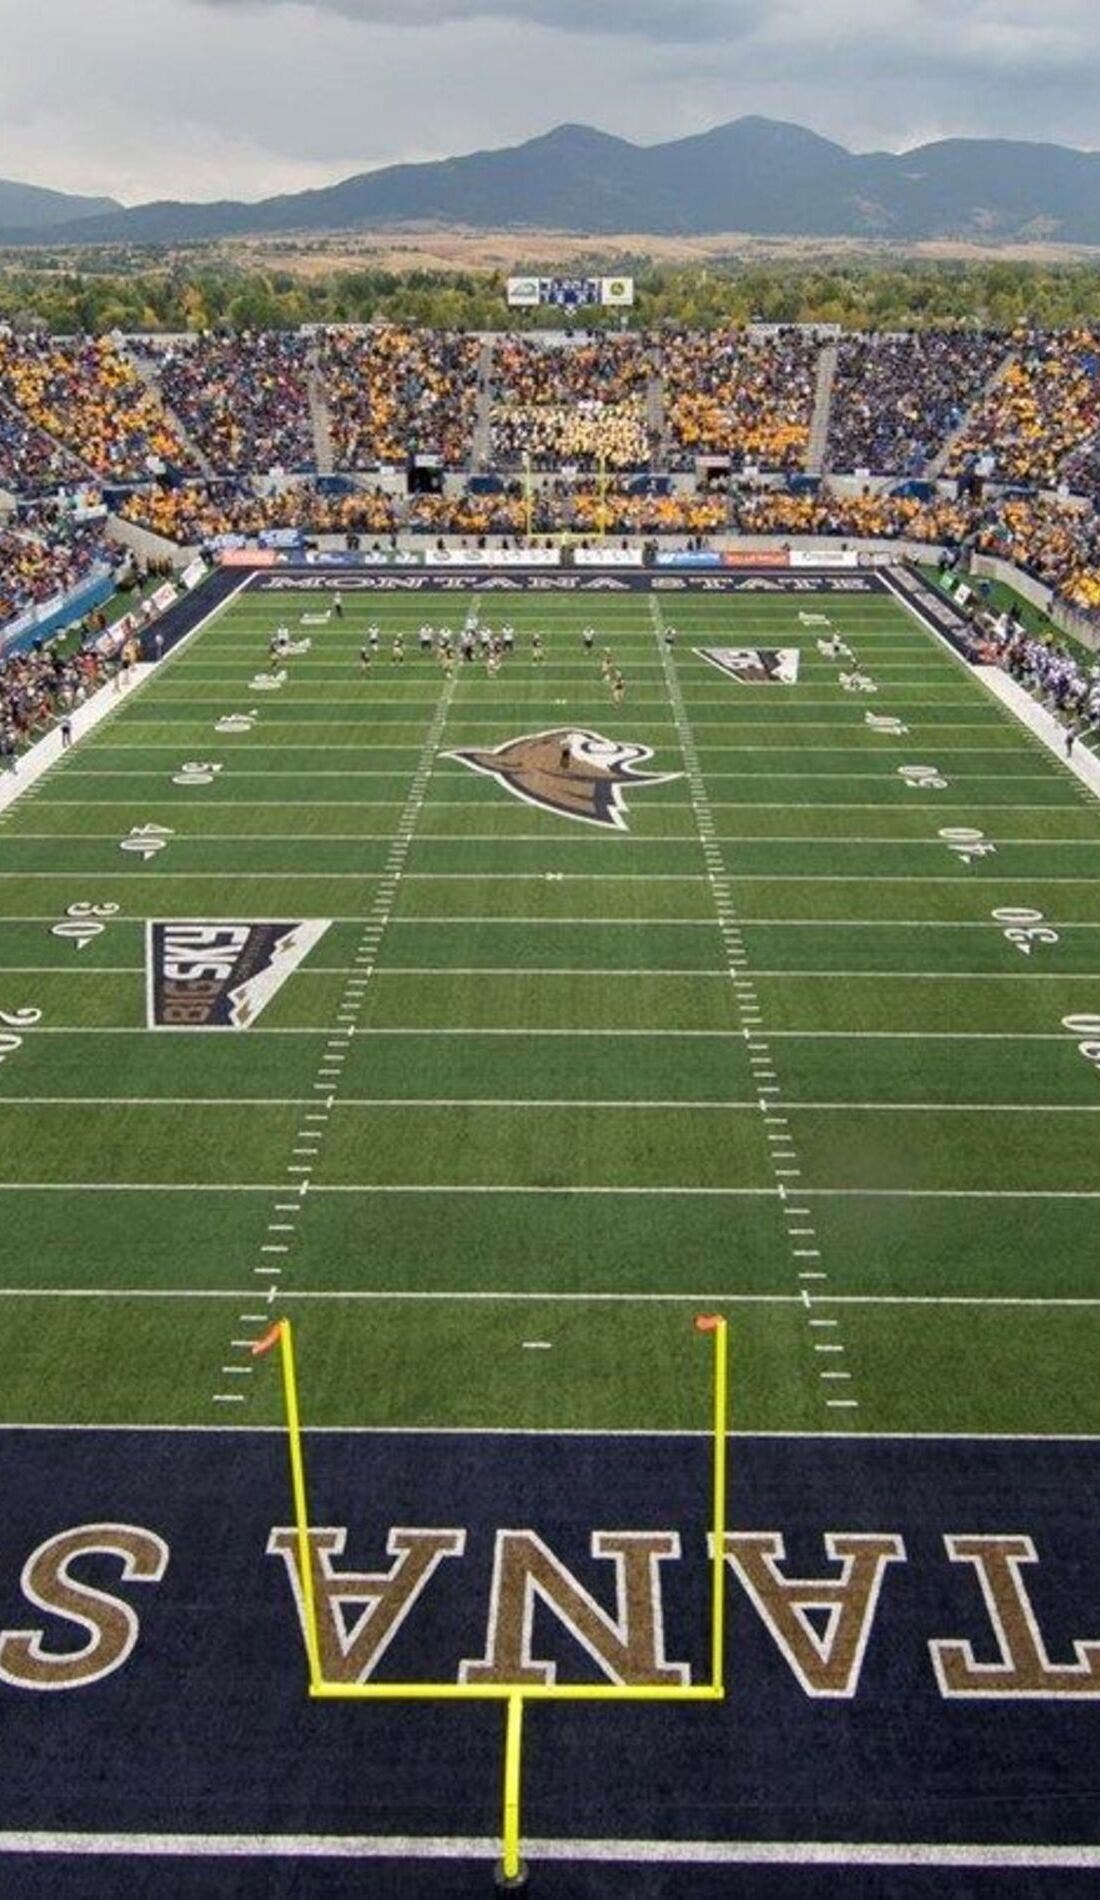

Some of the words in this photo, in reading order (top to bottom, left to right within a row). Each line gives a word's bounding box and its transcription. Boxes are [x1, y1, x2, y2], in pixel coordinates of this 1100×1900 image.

[261, 576, 631, 590] MONTANA
[650, 576, 871, 590] STATE
[172, 762, 223, 785] 50
[898, 765, 948, 789] 50
[119, 823, 175, 851] 40
[938, 827, 997, 856] 40
[51, 902, 120, 937] 30
[991, 907, 1059, 944] 30
[163, 925, 251, 981] SKY
[163, 979, 225, 1023] BIG
